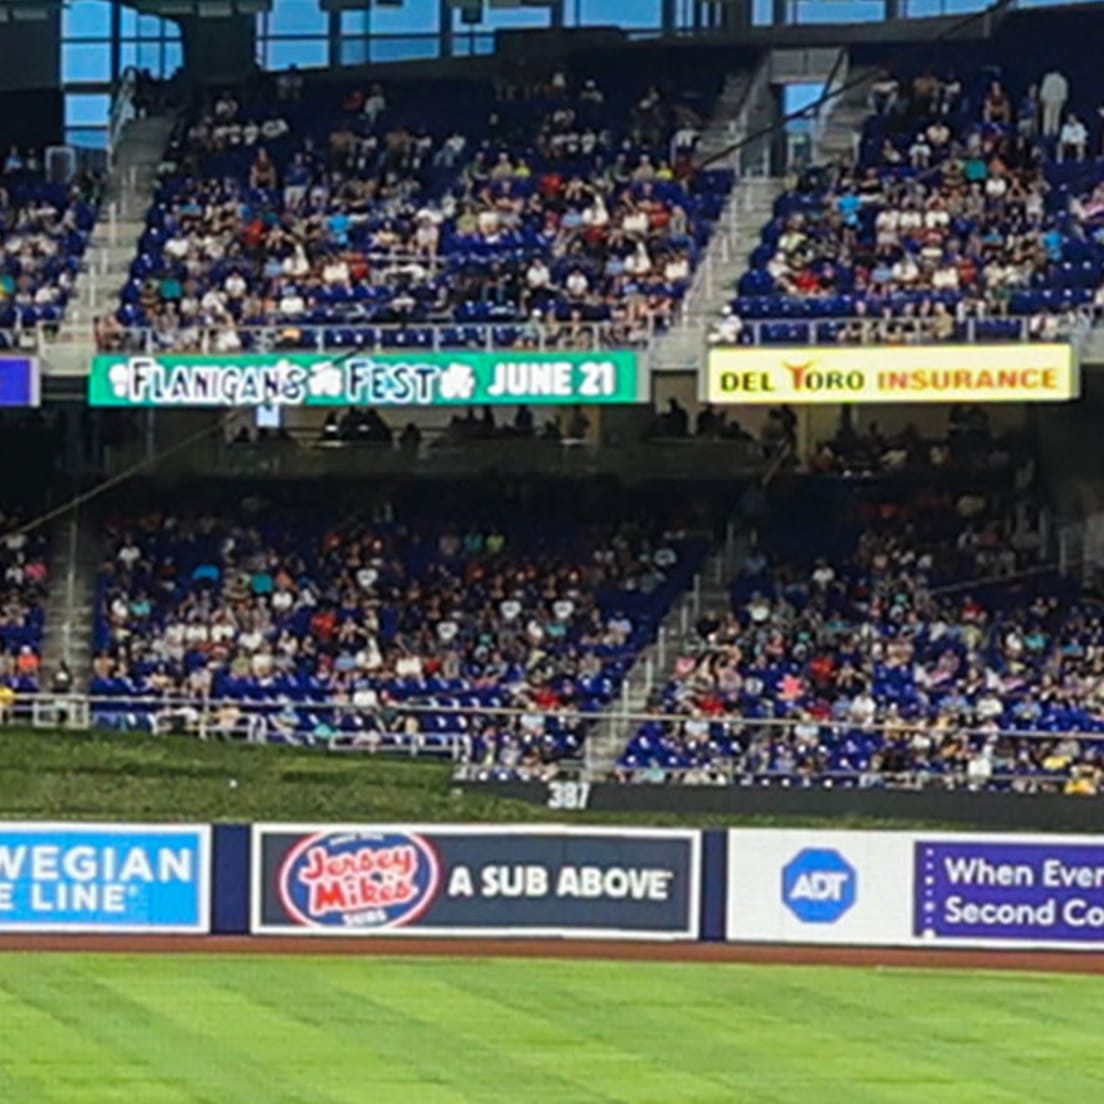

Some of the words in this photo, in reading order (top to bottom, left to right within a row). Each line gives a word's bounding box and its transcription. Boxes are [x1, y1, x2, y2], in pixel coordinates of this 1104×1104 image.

[345, 358, 439, 404] FEST
[489, 362, 573, 396] JUNE
[579, 362, 615, 394] 21
[720, 371, 774, 392] DEL
[783, 360, 865, 391] TORO
[877, 368, 1059, 391] INSURANCE
[549, 782, 591, 809] 387
[301, 847, 415, 881] Jersey
[945, 857, 1034, 886] When
[449, 866, 473, 896] A
[482, 866, 548, 896] SUB
[557, 866, 669, 900] ABOVE
[790, 872, 848, 900] ADT
[945, 896, 1055, 925] Second
